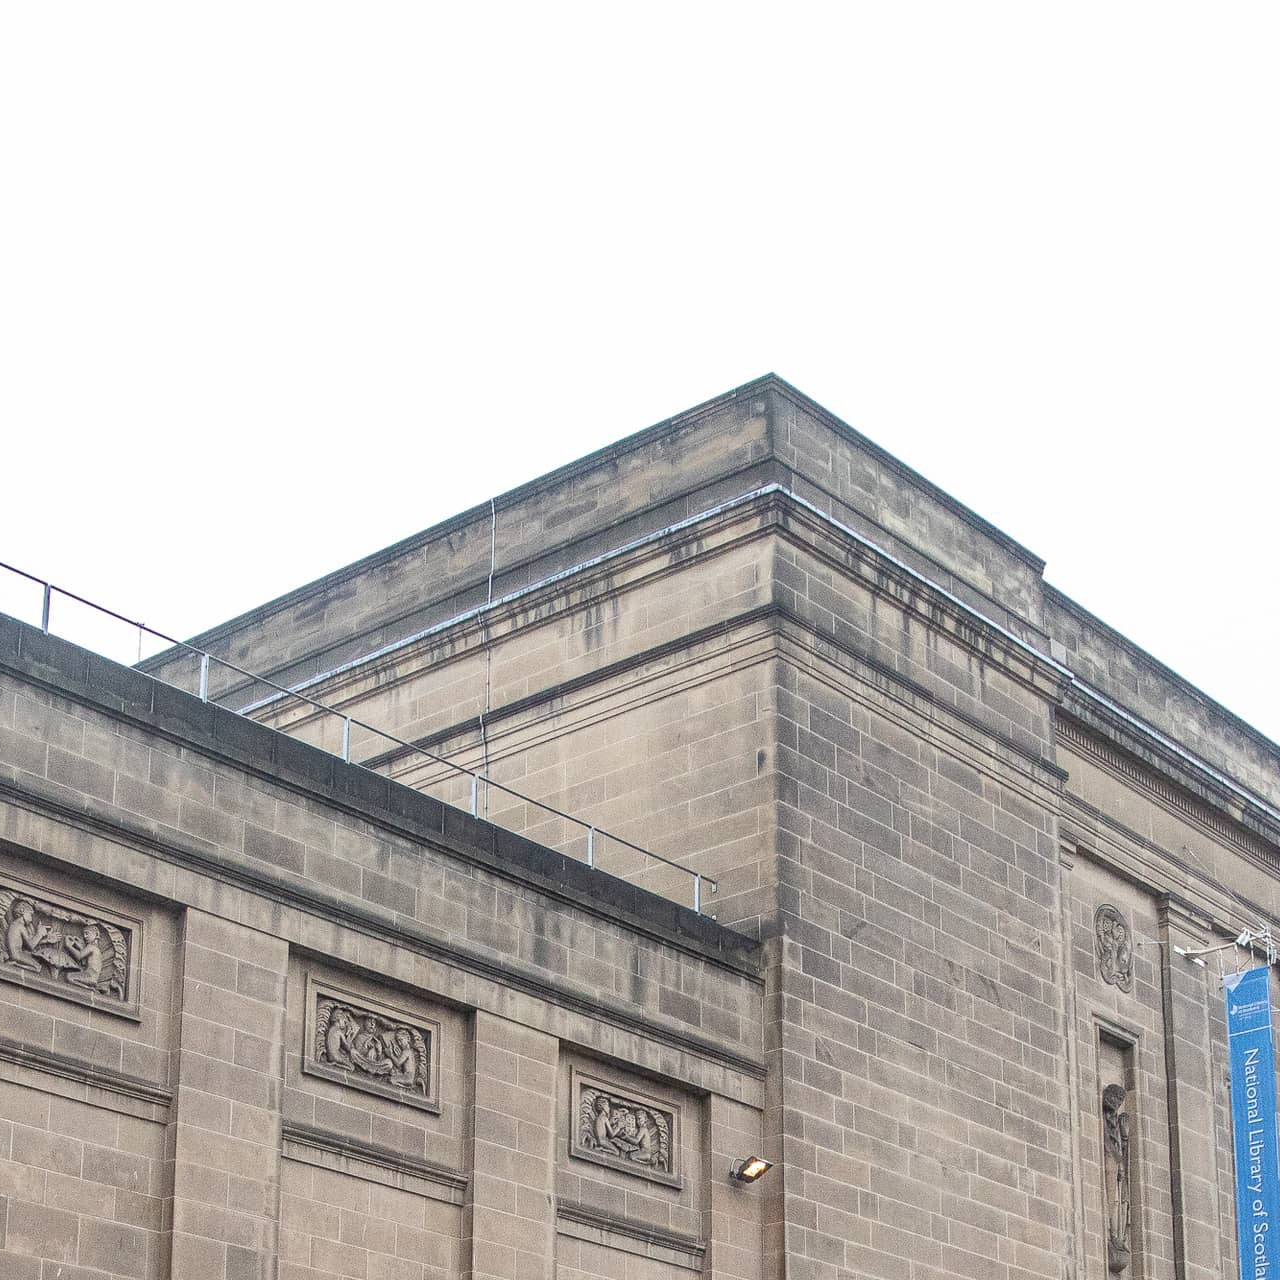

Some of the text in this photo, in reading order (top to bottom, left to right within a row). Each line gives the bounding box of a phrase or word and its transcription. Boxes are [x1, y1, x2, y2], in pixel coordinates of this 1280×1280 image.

[1244, 1047, 1264, 1124] National
[1248, 1129, 1266, 1193] Library
[1252, 1199, 1269, 1218] of
